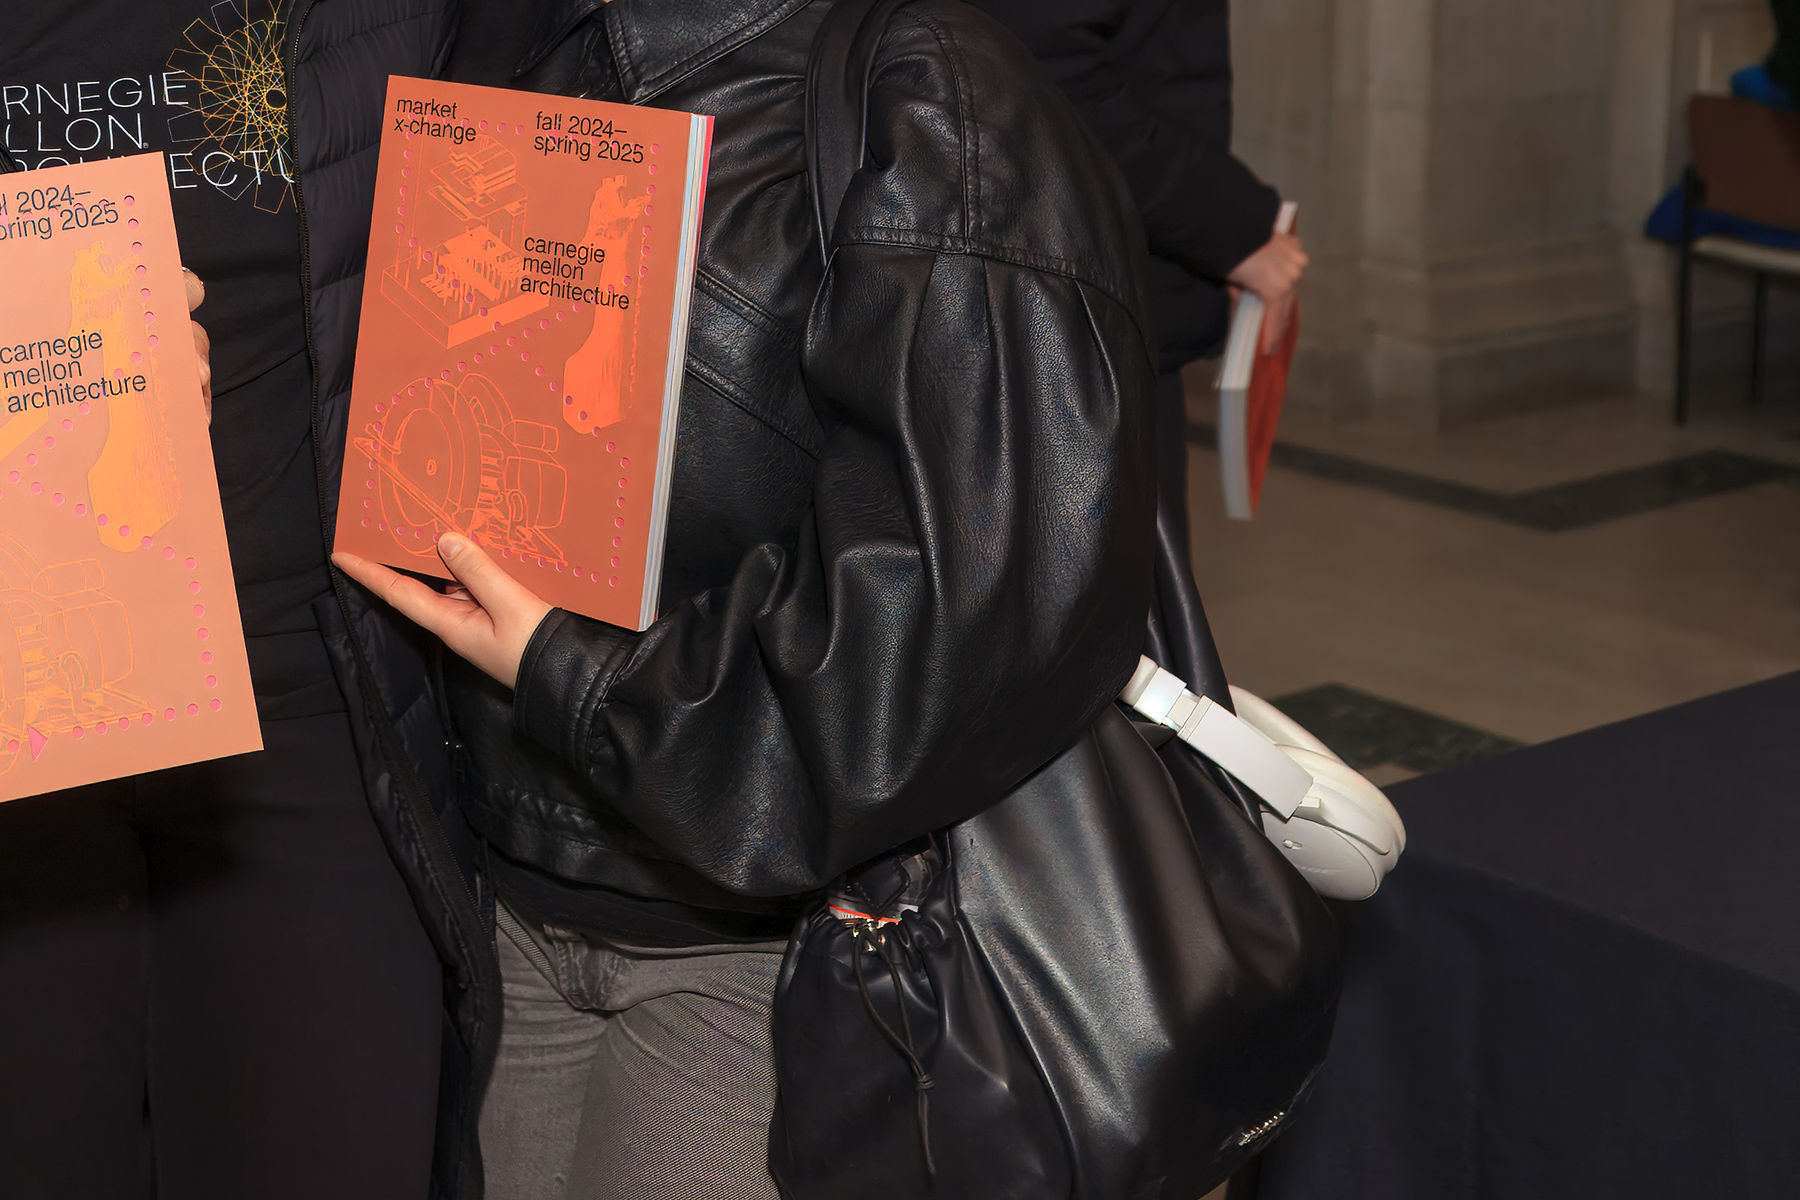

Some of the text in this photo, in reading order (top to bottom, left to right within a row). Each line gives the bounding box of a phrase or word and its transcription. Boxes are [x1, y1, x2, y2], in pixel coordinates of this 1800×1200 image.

[396, 98, 457, 119] market
[536, 111, 562, 131] fall
[5, 113, 144, 152] LLON
[394, 117, 477, 145] x-change
[534, 134, 644, 164] spring 2025
[60, 201, 119, 232] 2025
[524, 236, 606, 265] carnegie
[522, 256, 584, 281] mellon
[520, 276, 630, 310] architecture
[0, 329, 103, 365] carnegie
[3, 358, 82, 389] mellon
[7, 373, 147, 413] architecture
